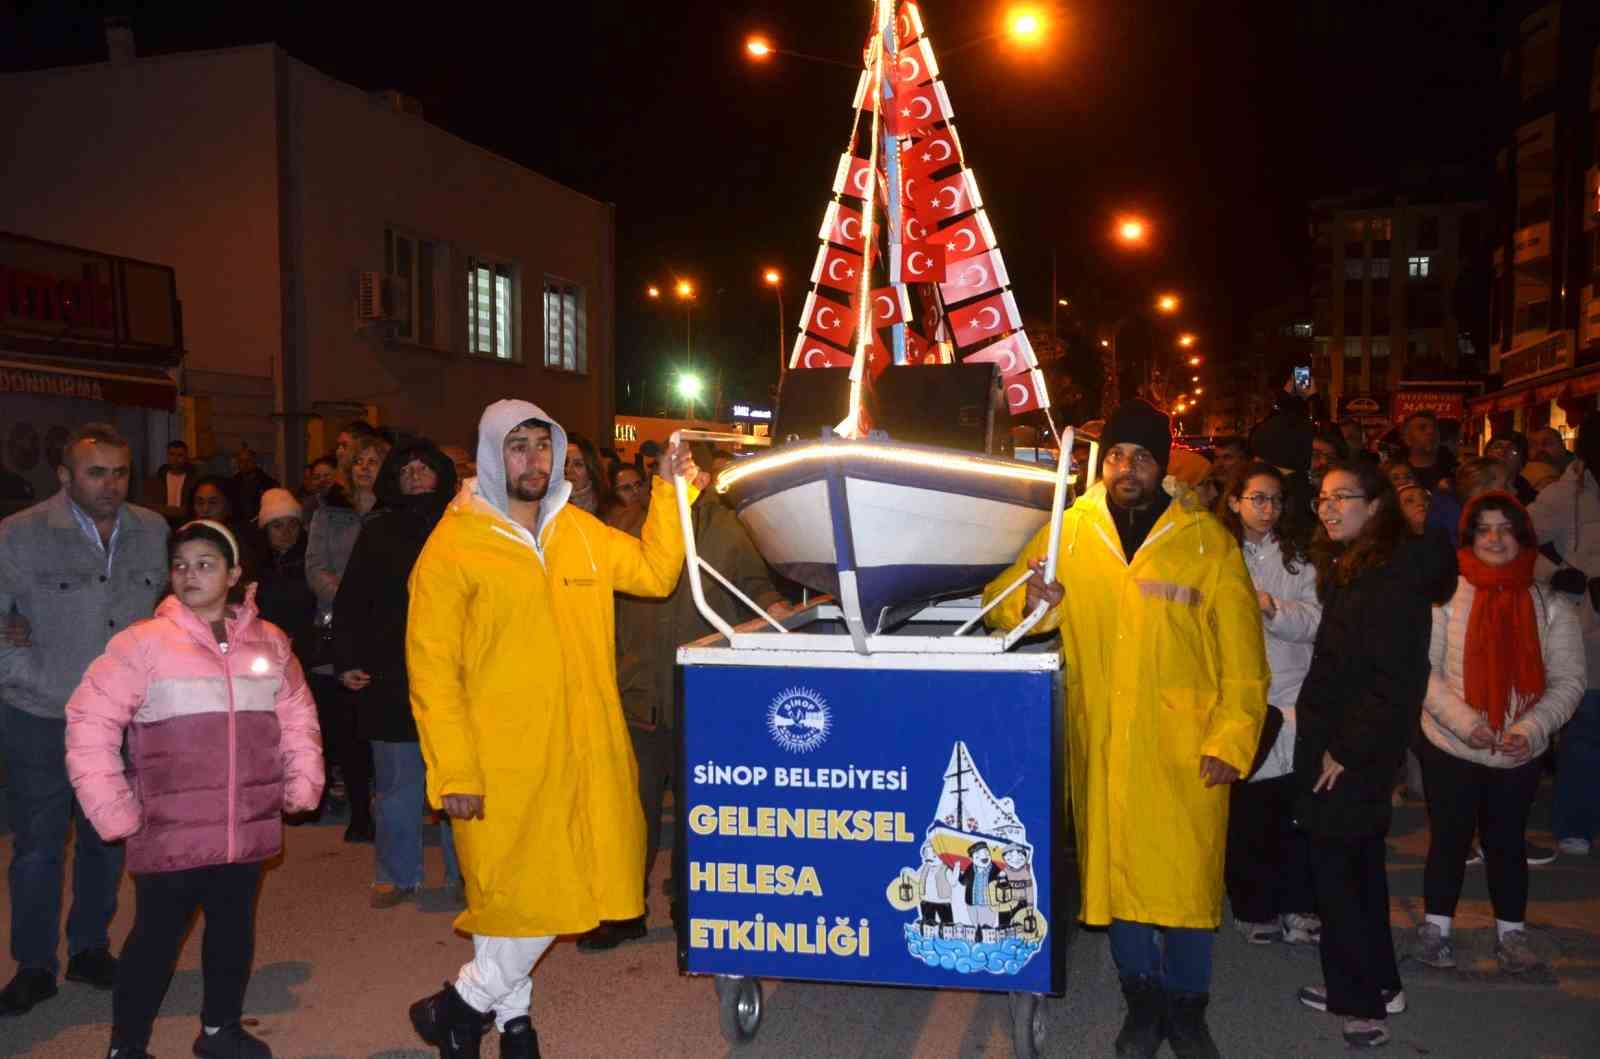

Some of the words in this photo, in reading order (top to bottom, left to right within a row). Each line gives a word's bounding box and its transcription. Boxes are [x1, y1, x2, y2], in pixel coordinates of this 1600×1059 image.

[693, 760, 768, 785] SİNOP
[775, 766, 908, 790] BELEDİYESİ
[688, 805, 914, 842] GELENEKSEL
[689, 862, 822, 896] HELESA
[690, 913, 870, 956] ETKİNLİĞİ
